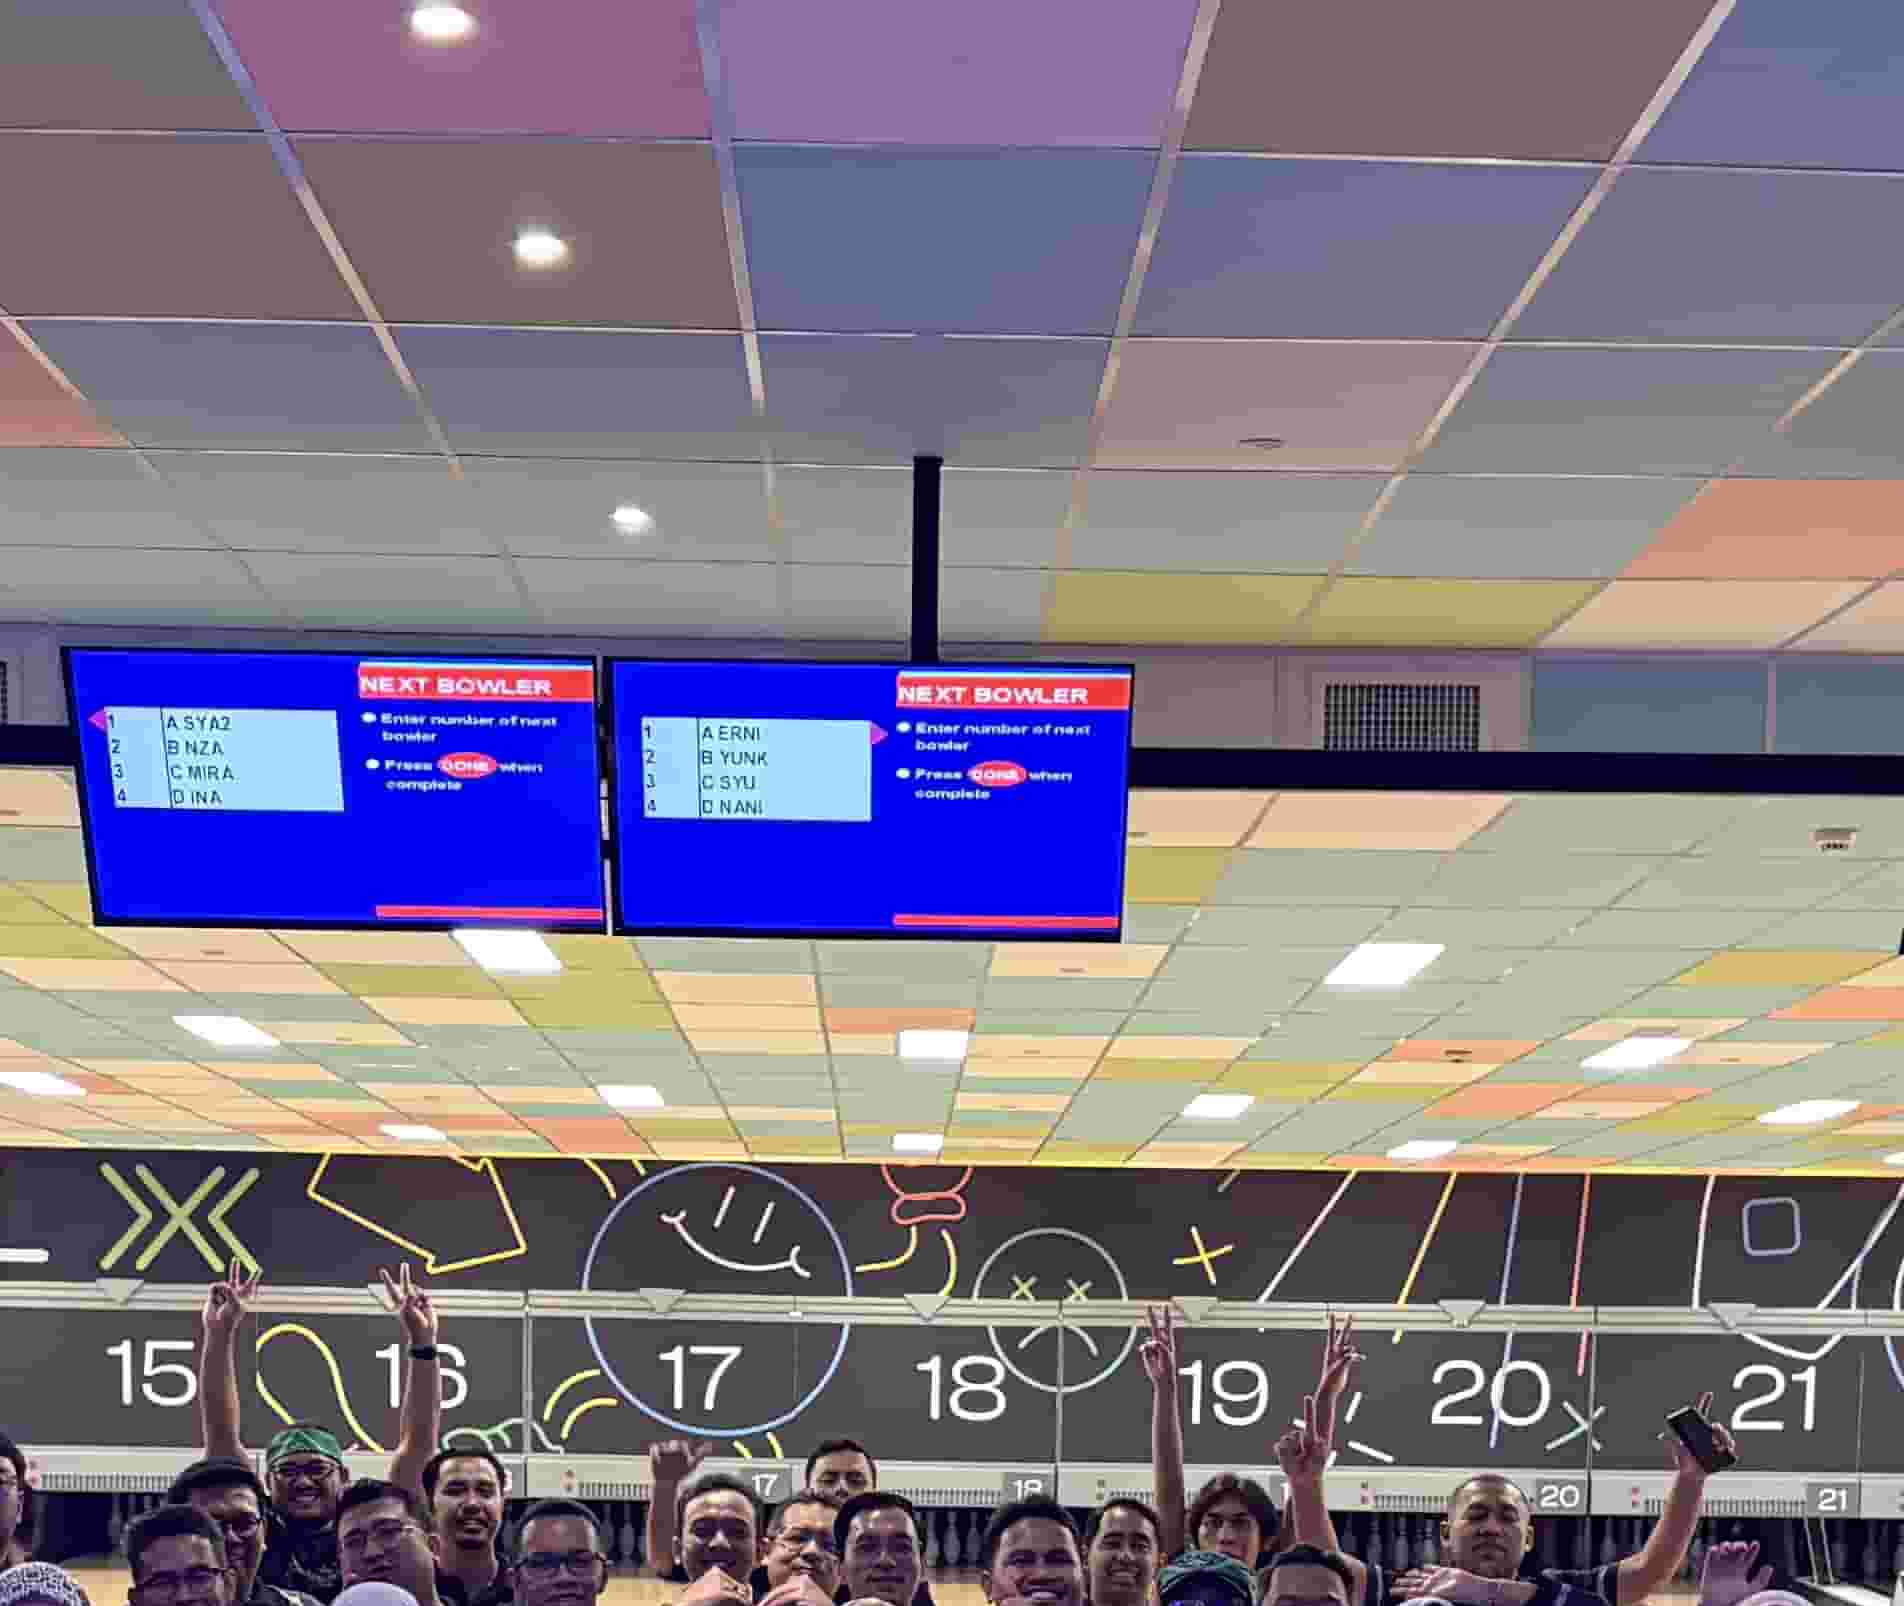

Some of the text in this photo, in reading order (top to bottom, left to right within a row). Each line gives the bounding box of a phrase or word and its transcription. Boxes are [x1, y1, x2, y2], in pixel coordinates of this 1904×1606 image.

[360, 677, 552, 695] NEXT BOWLER
[897, 686, 1089, 704] NEXT BOWLER
[719, 726, 760, 741] ERNI
[915, 722, 1091, 736] Enter number of next
[915, 740, 969, 751] bowler
[188, 765, 234, 781] MIRA
[914, 768, 963, 780] Press
[719, 775, 756, 790] SYU
[191, 790, 223, 805] INA
[914, 788, 991, 800] complete
[719, 800, 763, 815] NANI
[106, 1340, 198, 1406] 15
[659, 1345, 742, 1411] 17
[916, 1355, 1007, 1421] 18
[1179, 1360, 1269, 1425] 19
[1431, 1360, 1550, 1425] 20
[1732, 1365, 1816, 1431] 21
[751, 1474, 776, 1494] 17
[1542, 1486, 1580, 1507] 20
[1817, 1490, 1848, 1511] 21
